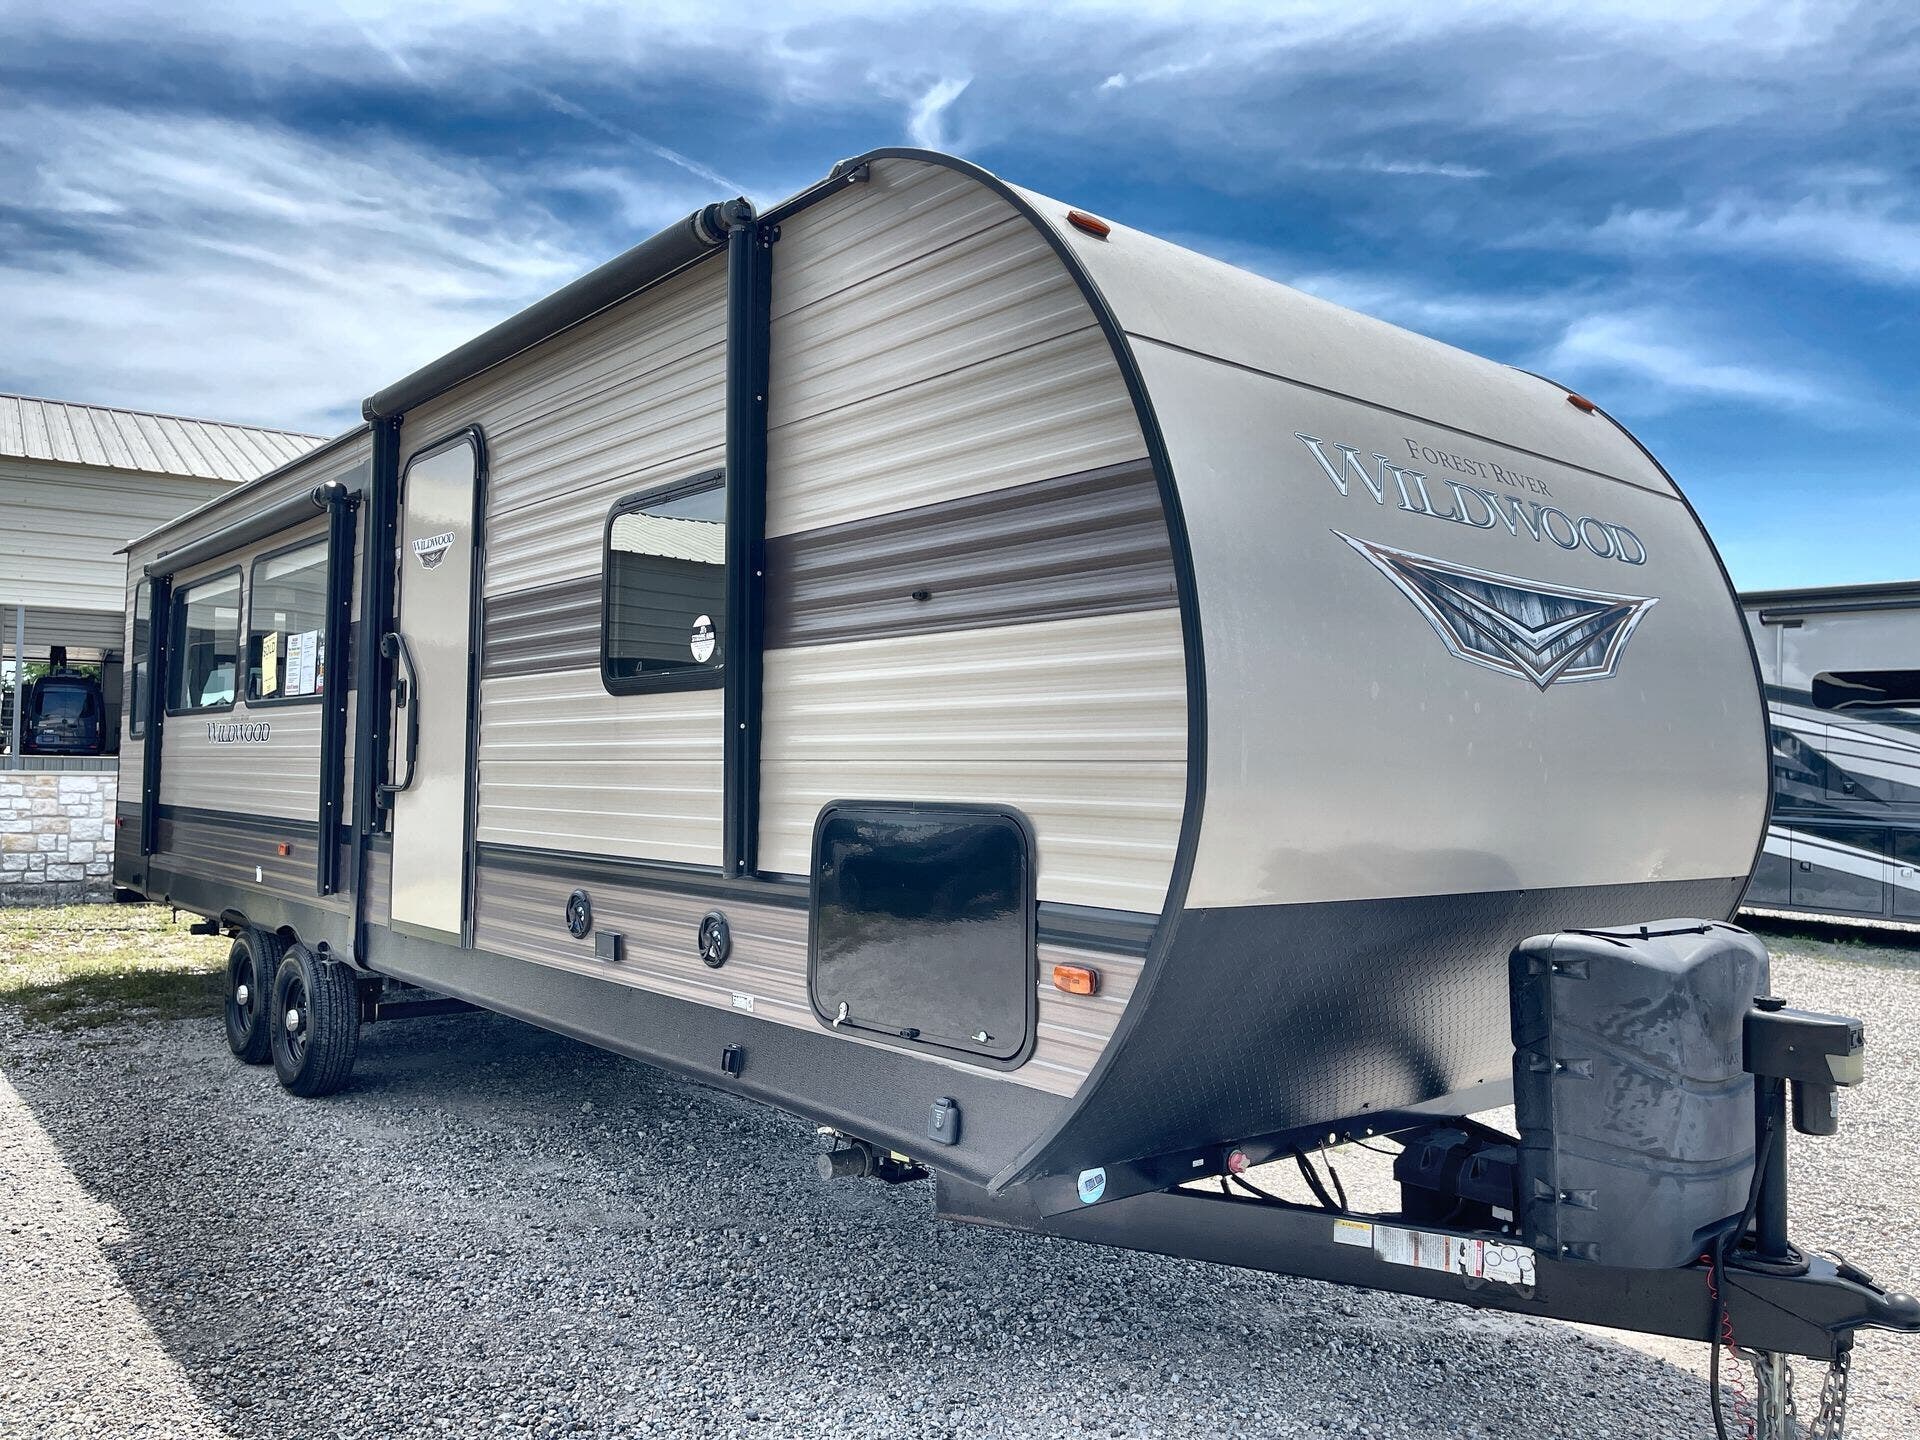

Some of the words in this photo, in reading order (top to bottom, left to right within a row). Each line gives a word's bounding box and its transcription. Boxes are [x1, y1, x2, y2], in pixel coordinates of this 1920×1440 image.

[1402, 437, 1488, 480] FOREST
[1488, 461, 1554, 498] RIVER
[1294, 431, 1647, 566] WILDWOOD
[412, 532, 455, 551] WILDWOOD
[207, 722, 271, 743] WILDWOOD
